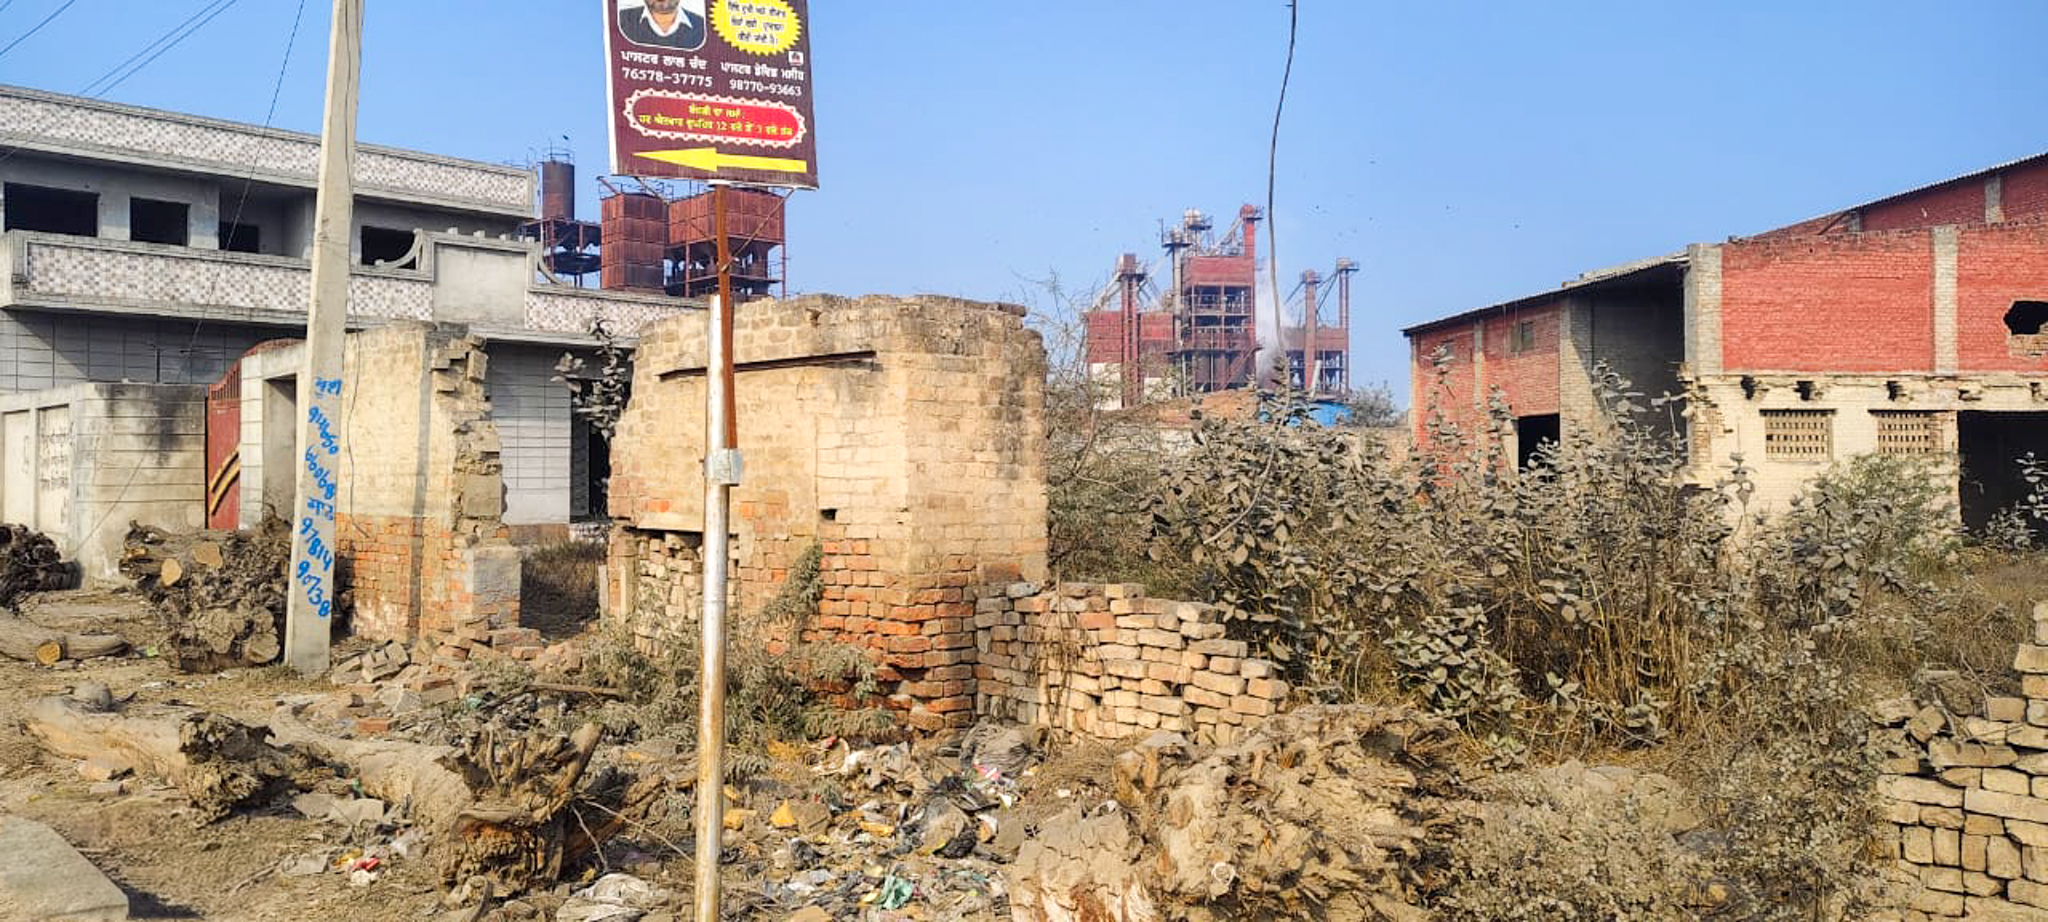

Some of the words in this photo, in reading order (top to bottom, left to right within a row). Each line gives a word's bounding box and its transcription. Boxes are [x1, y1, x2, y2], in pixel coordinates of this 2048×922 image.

[620, 51, 658, 64] ਪਾਸਟਰ
[662, 55, 685, 68] ਲਾਲ
[689, 55, 708, 70] ਚੰਦ
[622, 67, 712, 87] 76578-37775
[300, 518, 333, 571] 97814
[296, 561, 331, 617] 90738
